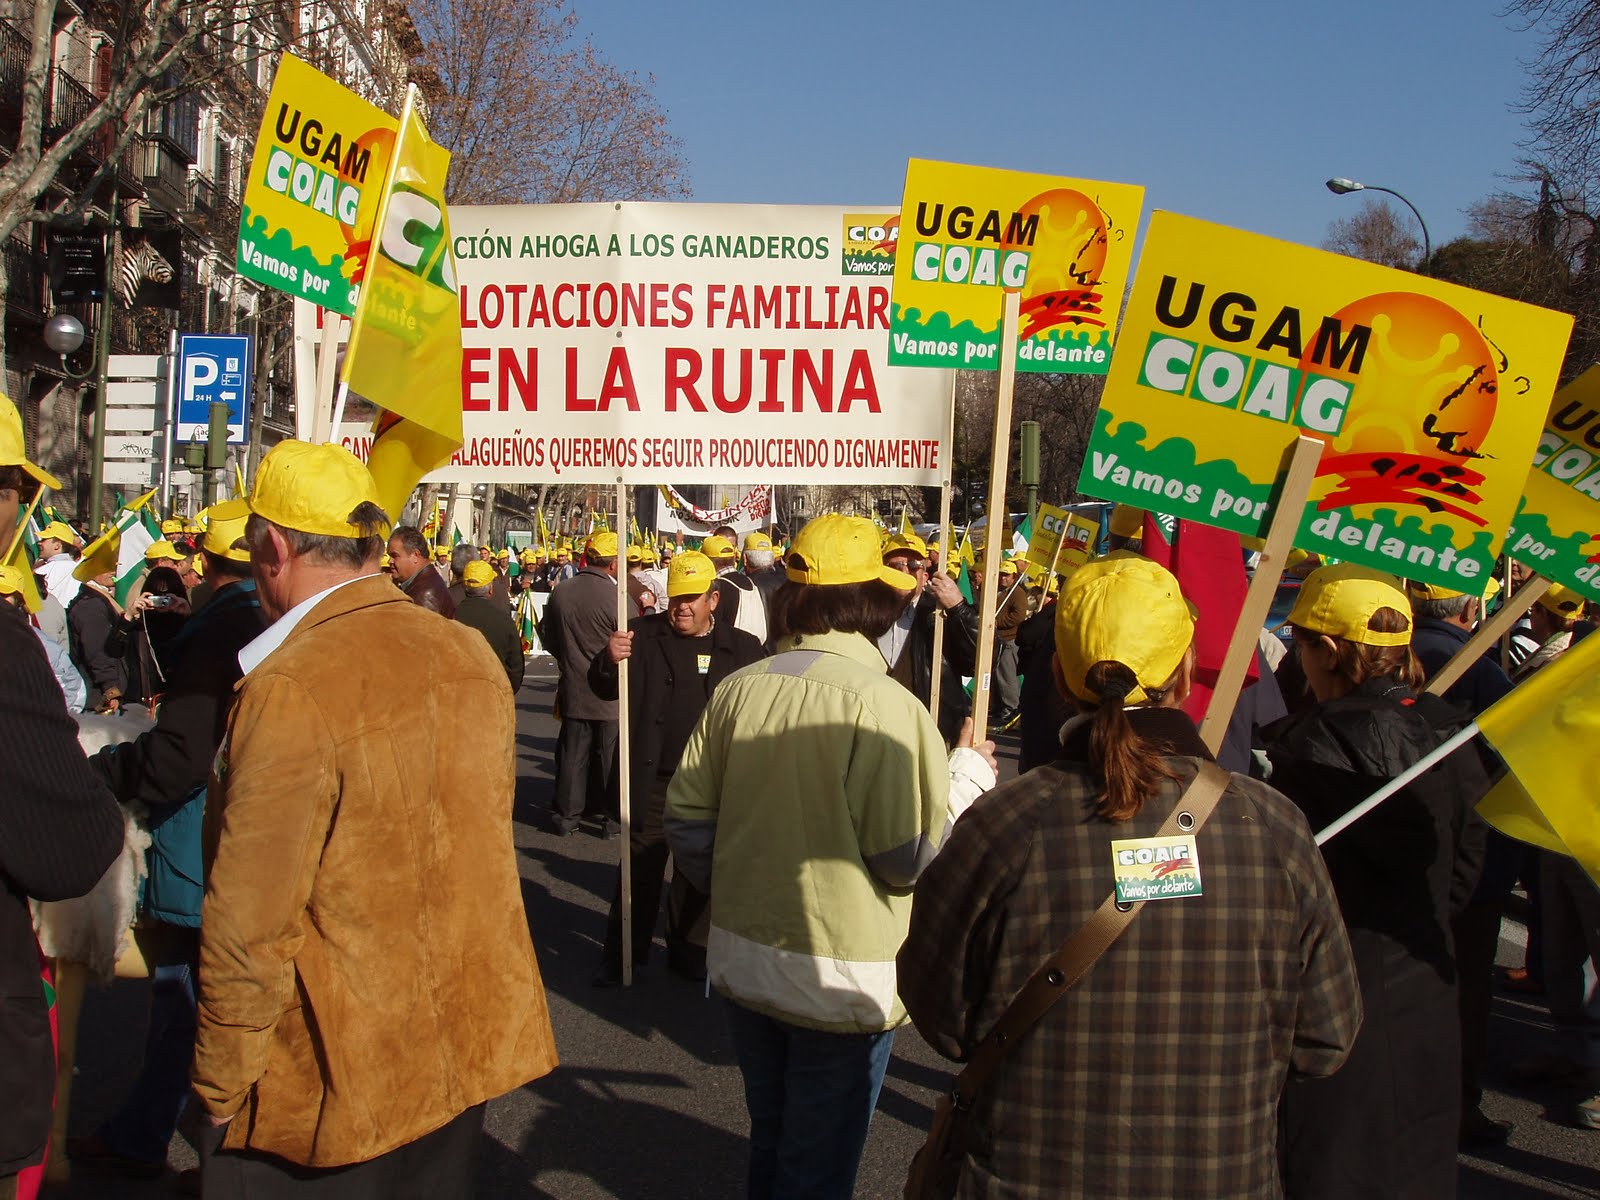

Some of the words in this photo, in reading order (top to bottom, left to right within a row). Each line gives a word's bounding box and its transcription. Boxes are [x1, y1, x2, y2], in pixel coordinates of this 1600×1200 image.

[275, 102, 372, 184] UGAM
[266, 149, 361, 227] COAG
[519, 233, 600, 257] AHOGA
[606, 234, 622, 256] A
[630, 234, 675, 258] LOS
[682, 235, 830, 260] GANADEROS
[914, 201, 1041, 247] UGAM
[241, 239, 298, 282] Vamos
[302, 268, 331, 294] por
[845, 257, 878, 274] Vamos
[877, 262, 895, 276] por
[912, 242, 1029, 289] COAG
[892, 332, 958, 357] Vamos
[964, 341, 997, 363] por
[1018, 339, 1106, 364] delante
[1154, 275, 1374, 375] UGAM
[195, 394, 205, 402] 24
[461, 347, 539, 412] EN
[565, 346, 641, 412] LA
[664, 346, 882, 413] RUINA
[1143, 337, 1352, 436] COAG
[447, 429, 545, 467] ALAGUEÑOS
[549, 437, 637, 475] QUEREMOS
[642, 437, 704, 468] SEGUIR
[709, 438, 829, 468] PRODUCIENDO
[834, 439, 940, 470] DIGNAMENTE
[1043, 515, 1090, 543] COAG
[1092, 451, 1203, 504] Vamos
[1210, 486, 1271, 522] por
[1310, 502, 1482, 579] delante
[1511, 532, 1557, 561] por
[1118, 845, 1189, 866] COAG
[1119, 883, 1147, 898] Vamos
[1147, 884, 1161, 899] por
[1161, 877, 1195, 894] delante
